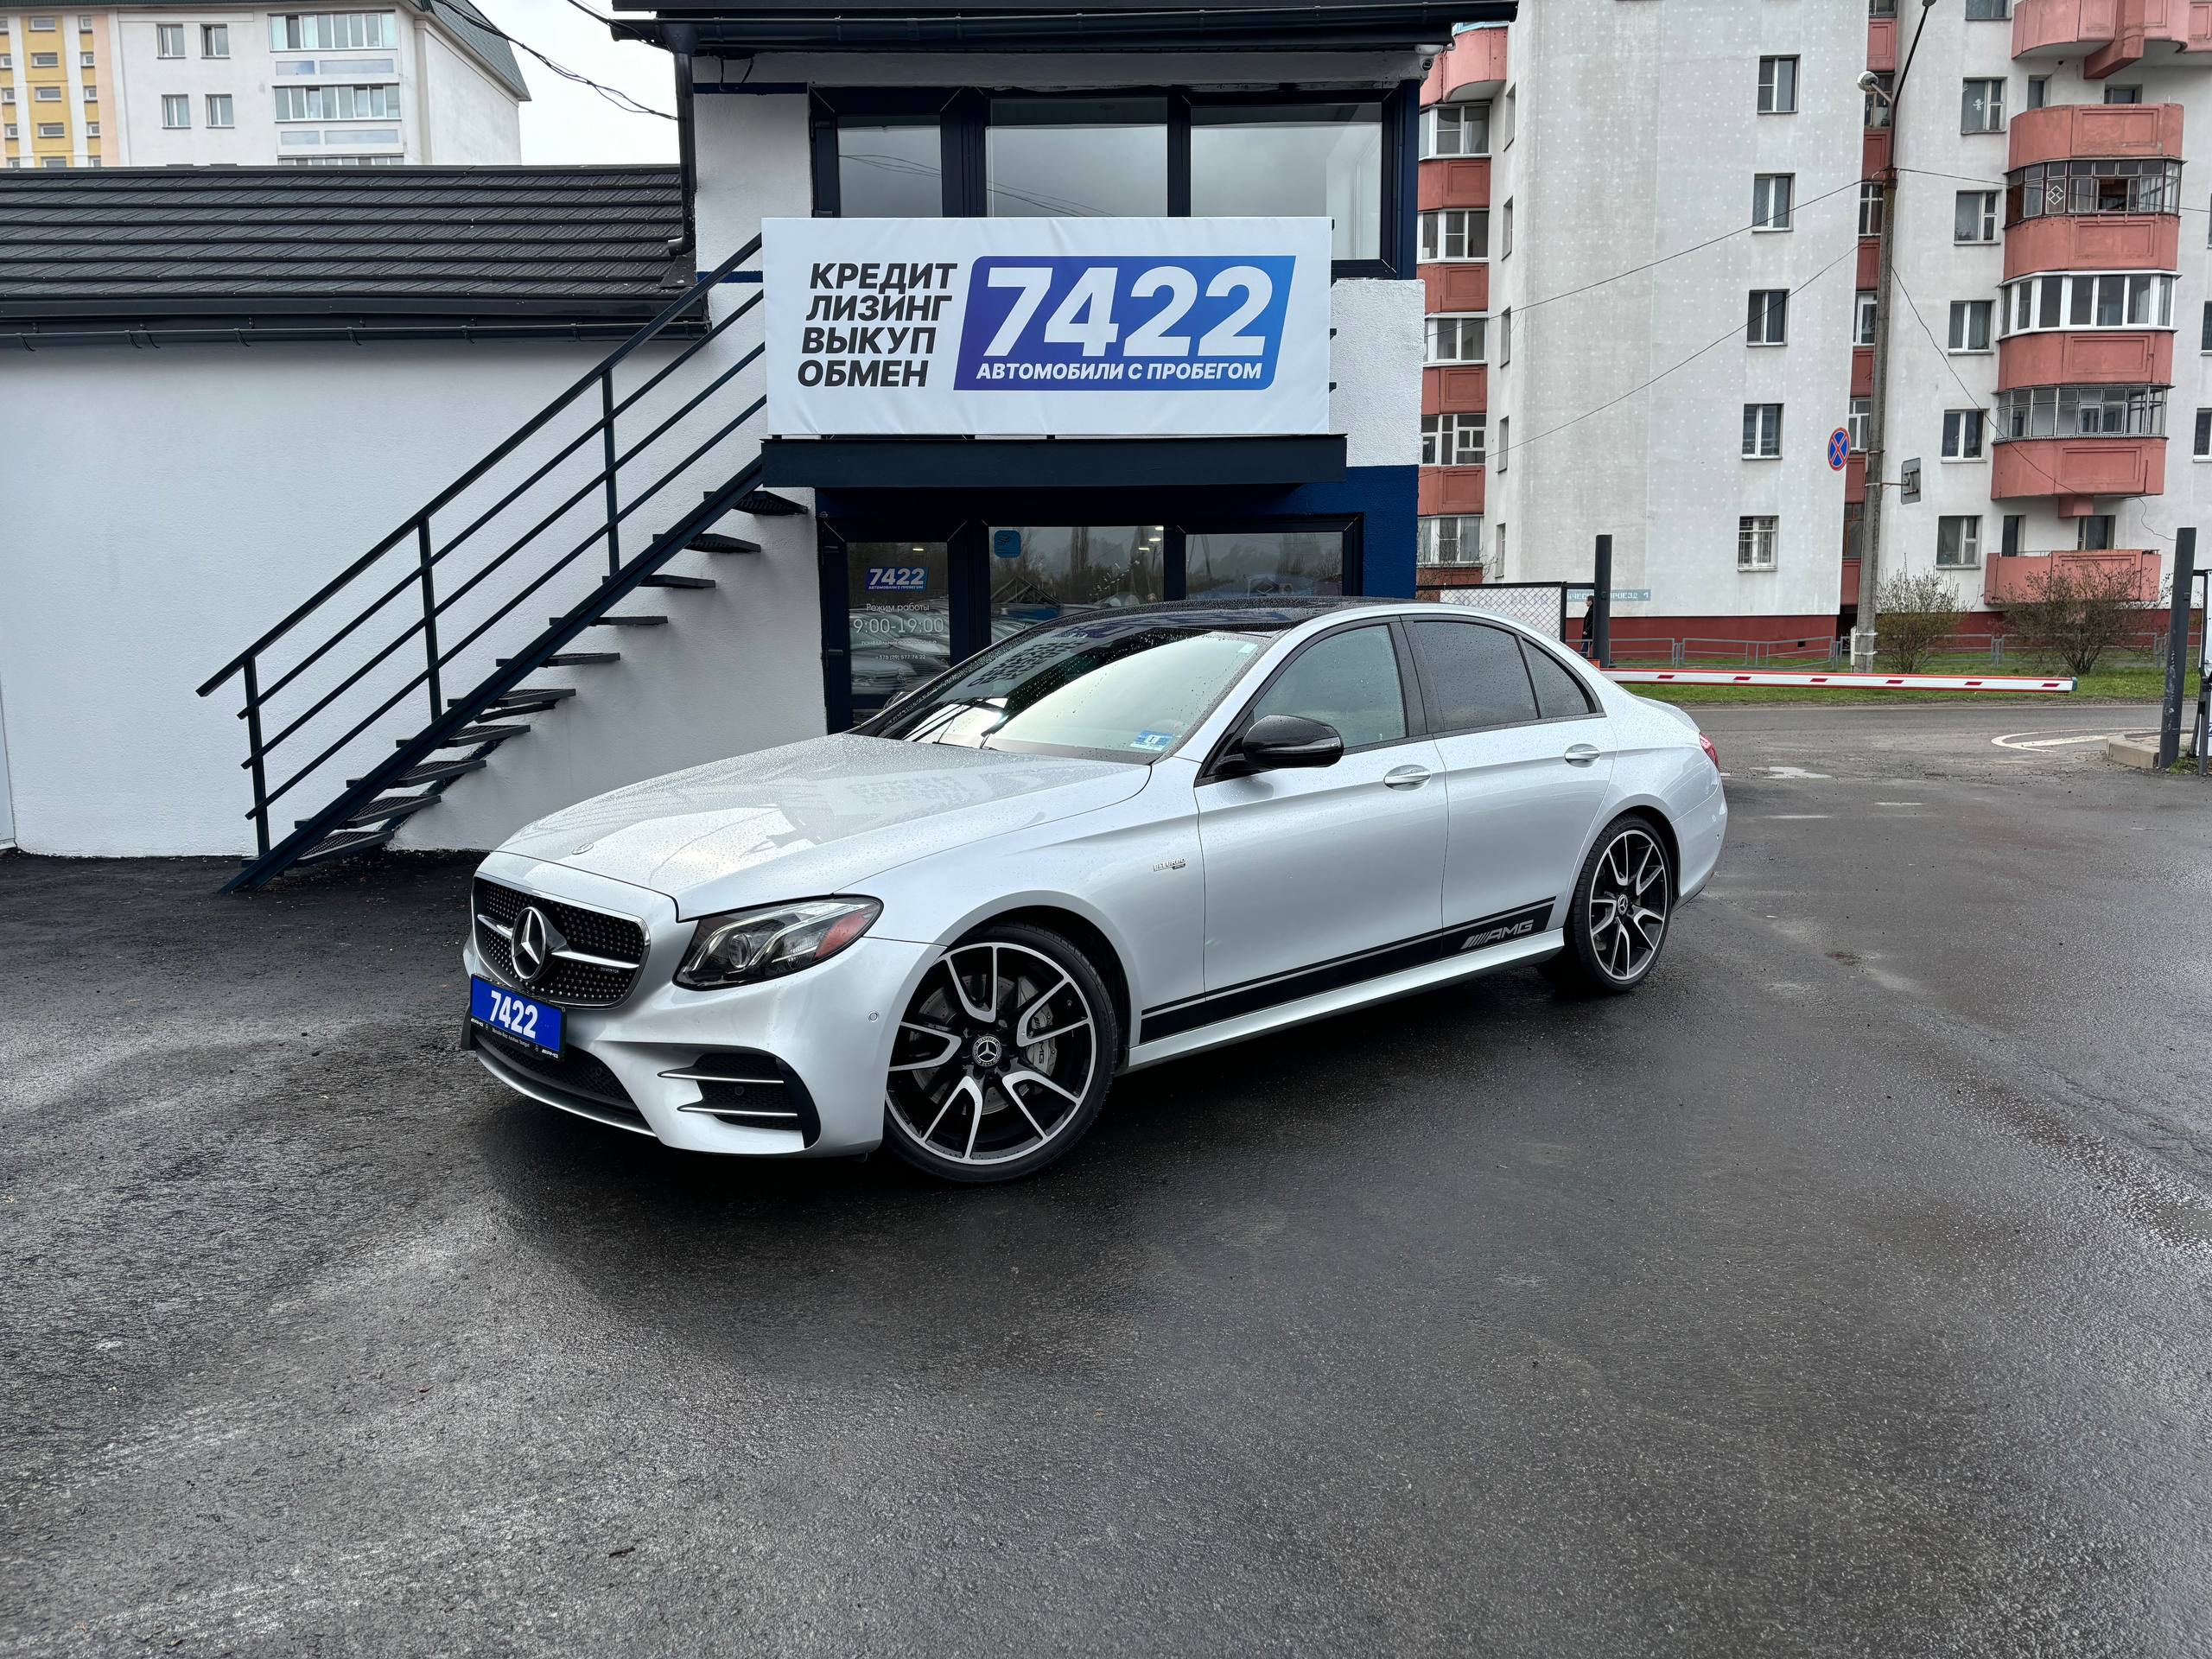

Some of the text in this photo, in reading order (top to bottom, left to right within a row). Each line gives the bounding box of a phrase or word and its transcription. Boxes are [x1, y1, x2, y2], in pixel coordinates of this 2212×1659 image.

[809, 263, 957, 291] КРЕДИТ
[805, 295, 953, 321] ЛИЗИНГ
[982, 265, 1274, 357] 7422
[801, 327, 937, 354] ВЫКУП
[797, 359, 929, 388] ОБМЕН
[976, 362, 1262, 381] АВТОМОБИЛИ С ПРОБЕГОМ
[869, 568, 925, 586] 7422
[866, 602, 930, 613] Режим работы
[853, 618, 944, 633] 9:00-19:00
[1484, 918, 1535, 944] AMG
[489, 989, 538, 1039] 7422
